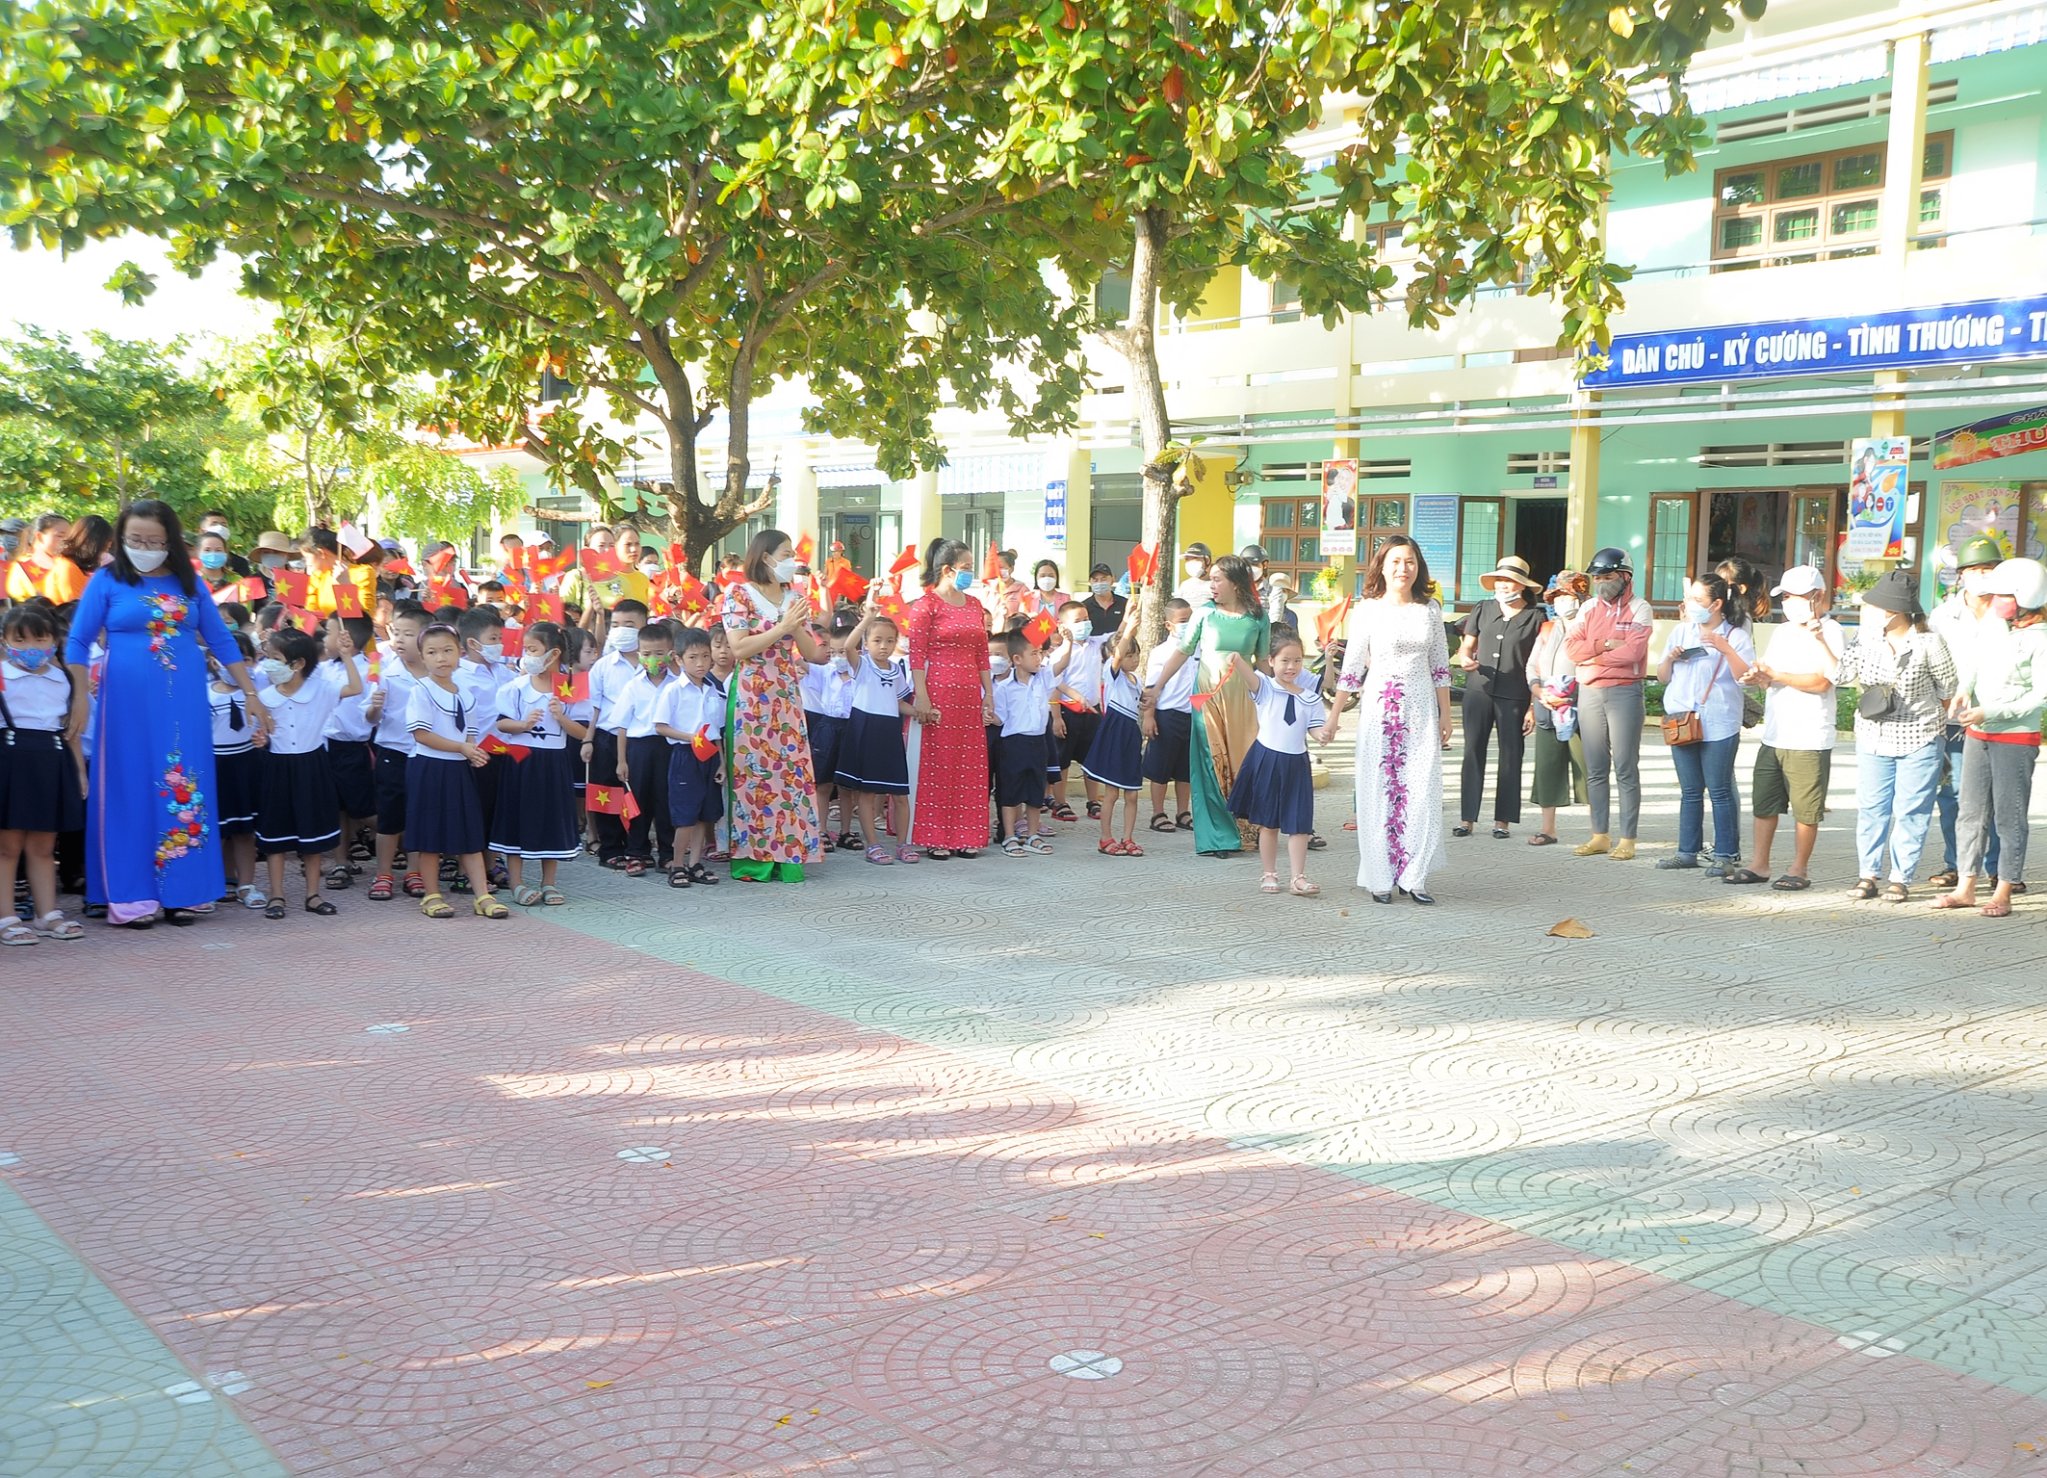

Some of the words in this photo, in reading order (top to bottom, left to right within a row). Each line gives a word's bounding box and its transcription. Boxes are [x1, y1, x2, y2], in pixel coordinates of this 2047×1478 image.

[1623, 343, 1659, 374] DÂN
[1665, 336, 1705, 371] CHỦ
[1709, 352, 1718, 360] -
[1723, 332, 1750, 367] KỶ
[1755, 330, 1827, 364] CƯƠNG
[1848, 322, 1900, 357] TÌNH
[1907, 313, 2005, 352] THƯƠNG
[2010, 327, 2022, 335] -
